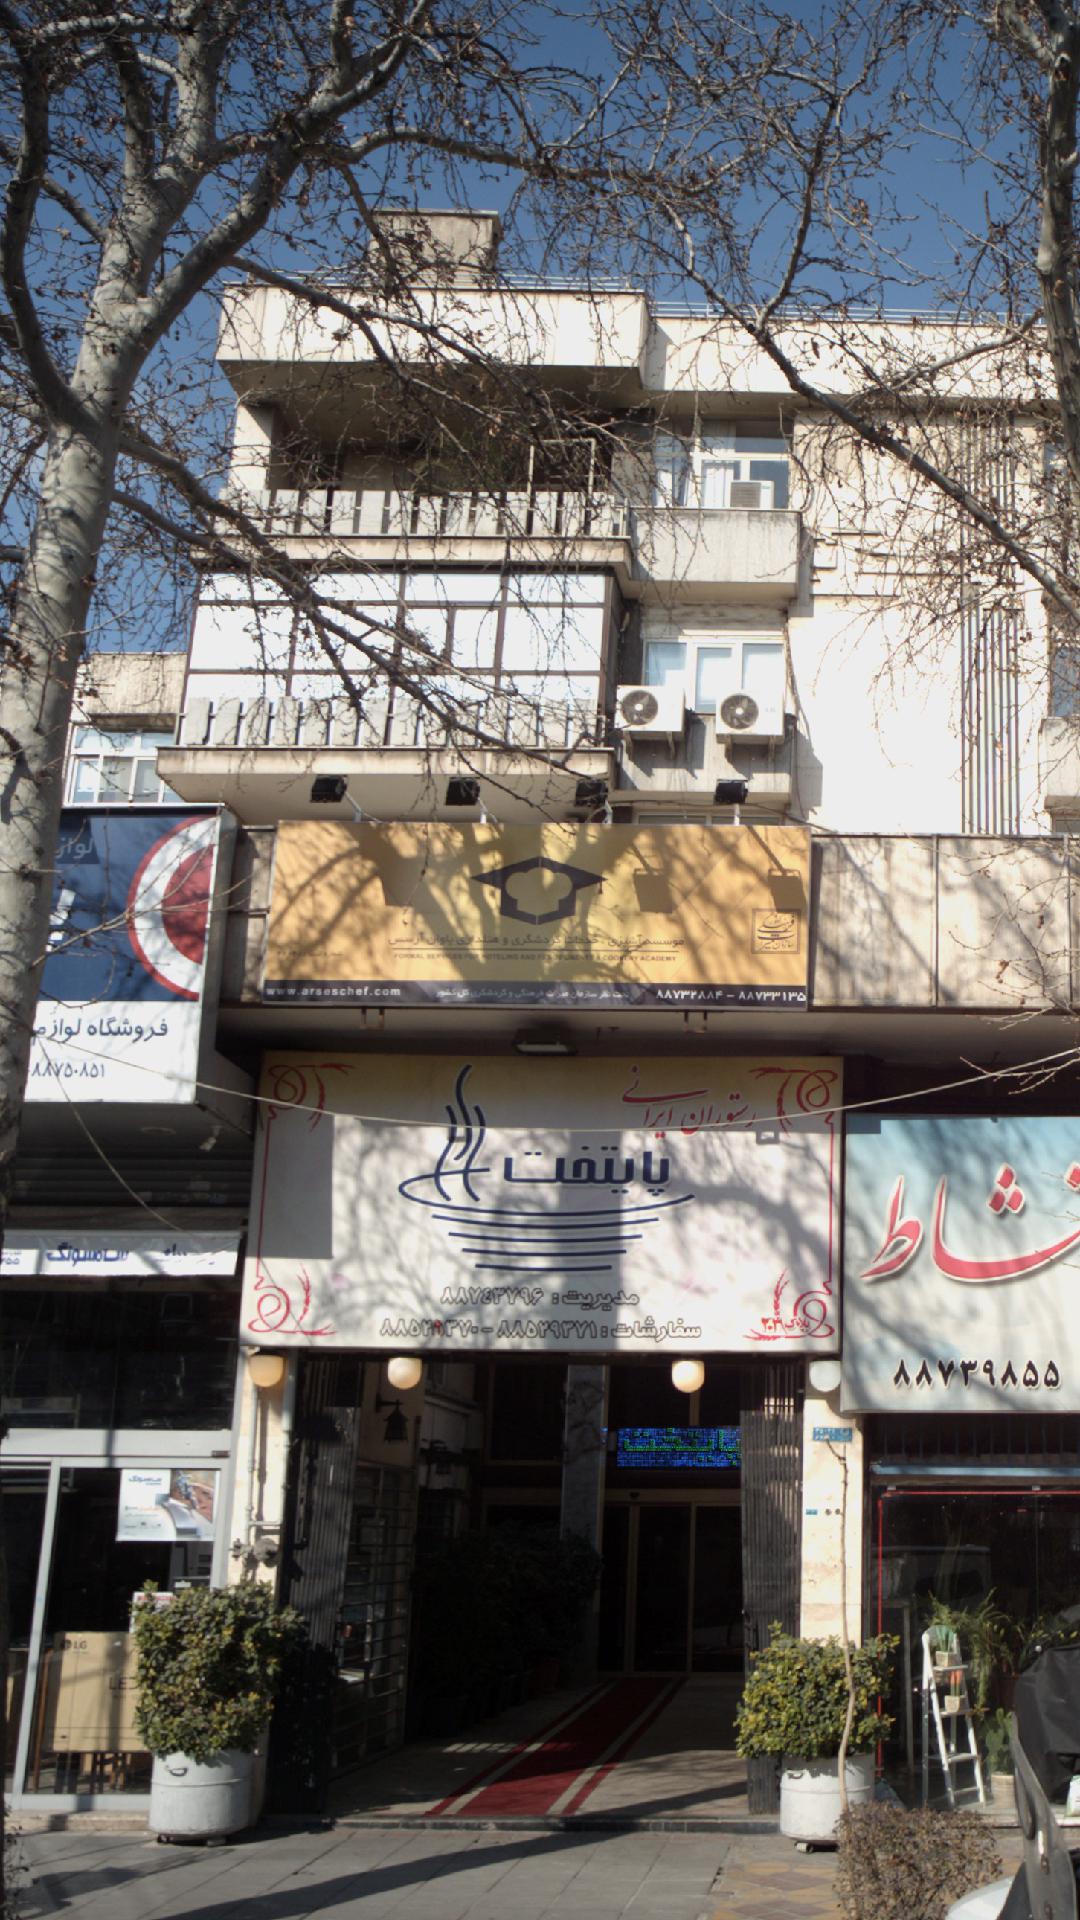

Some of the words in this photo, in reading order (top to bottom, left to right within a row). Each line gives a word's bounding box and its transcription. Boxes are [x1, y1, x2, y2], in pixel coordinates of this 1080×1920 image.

[88, 1017, 169, 1044] فروشگاه
[680, 1093, 757, 1136] رستوران
[503, 1145, 670, 1197] پایتخت
[892, 1358, 1062, 1389] ۸۸۷۳۹۸۵۵
